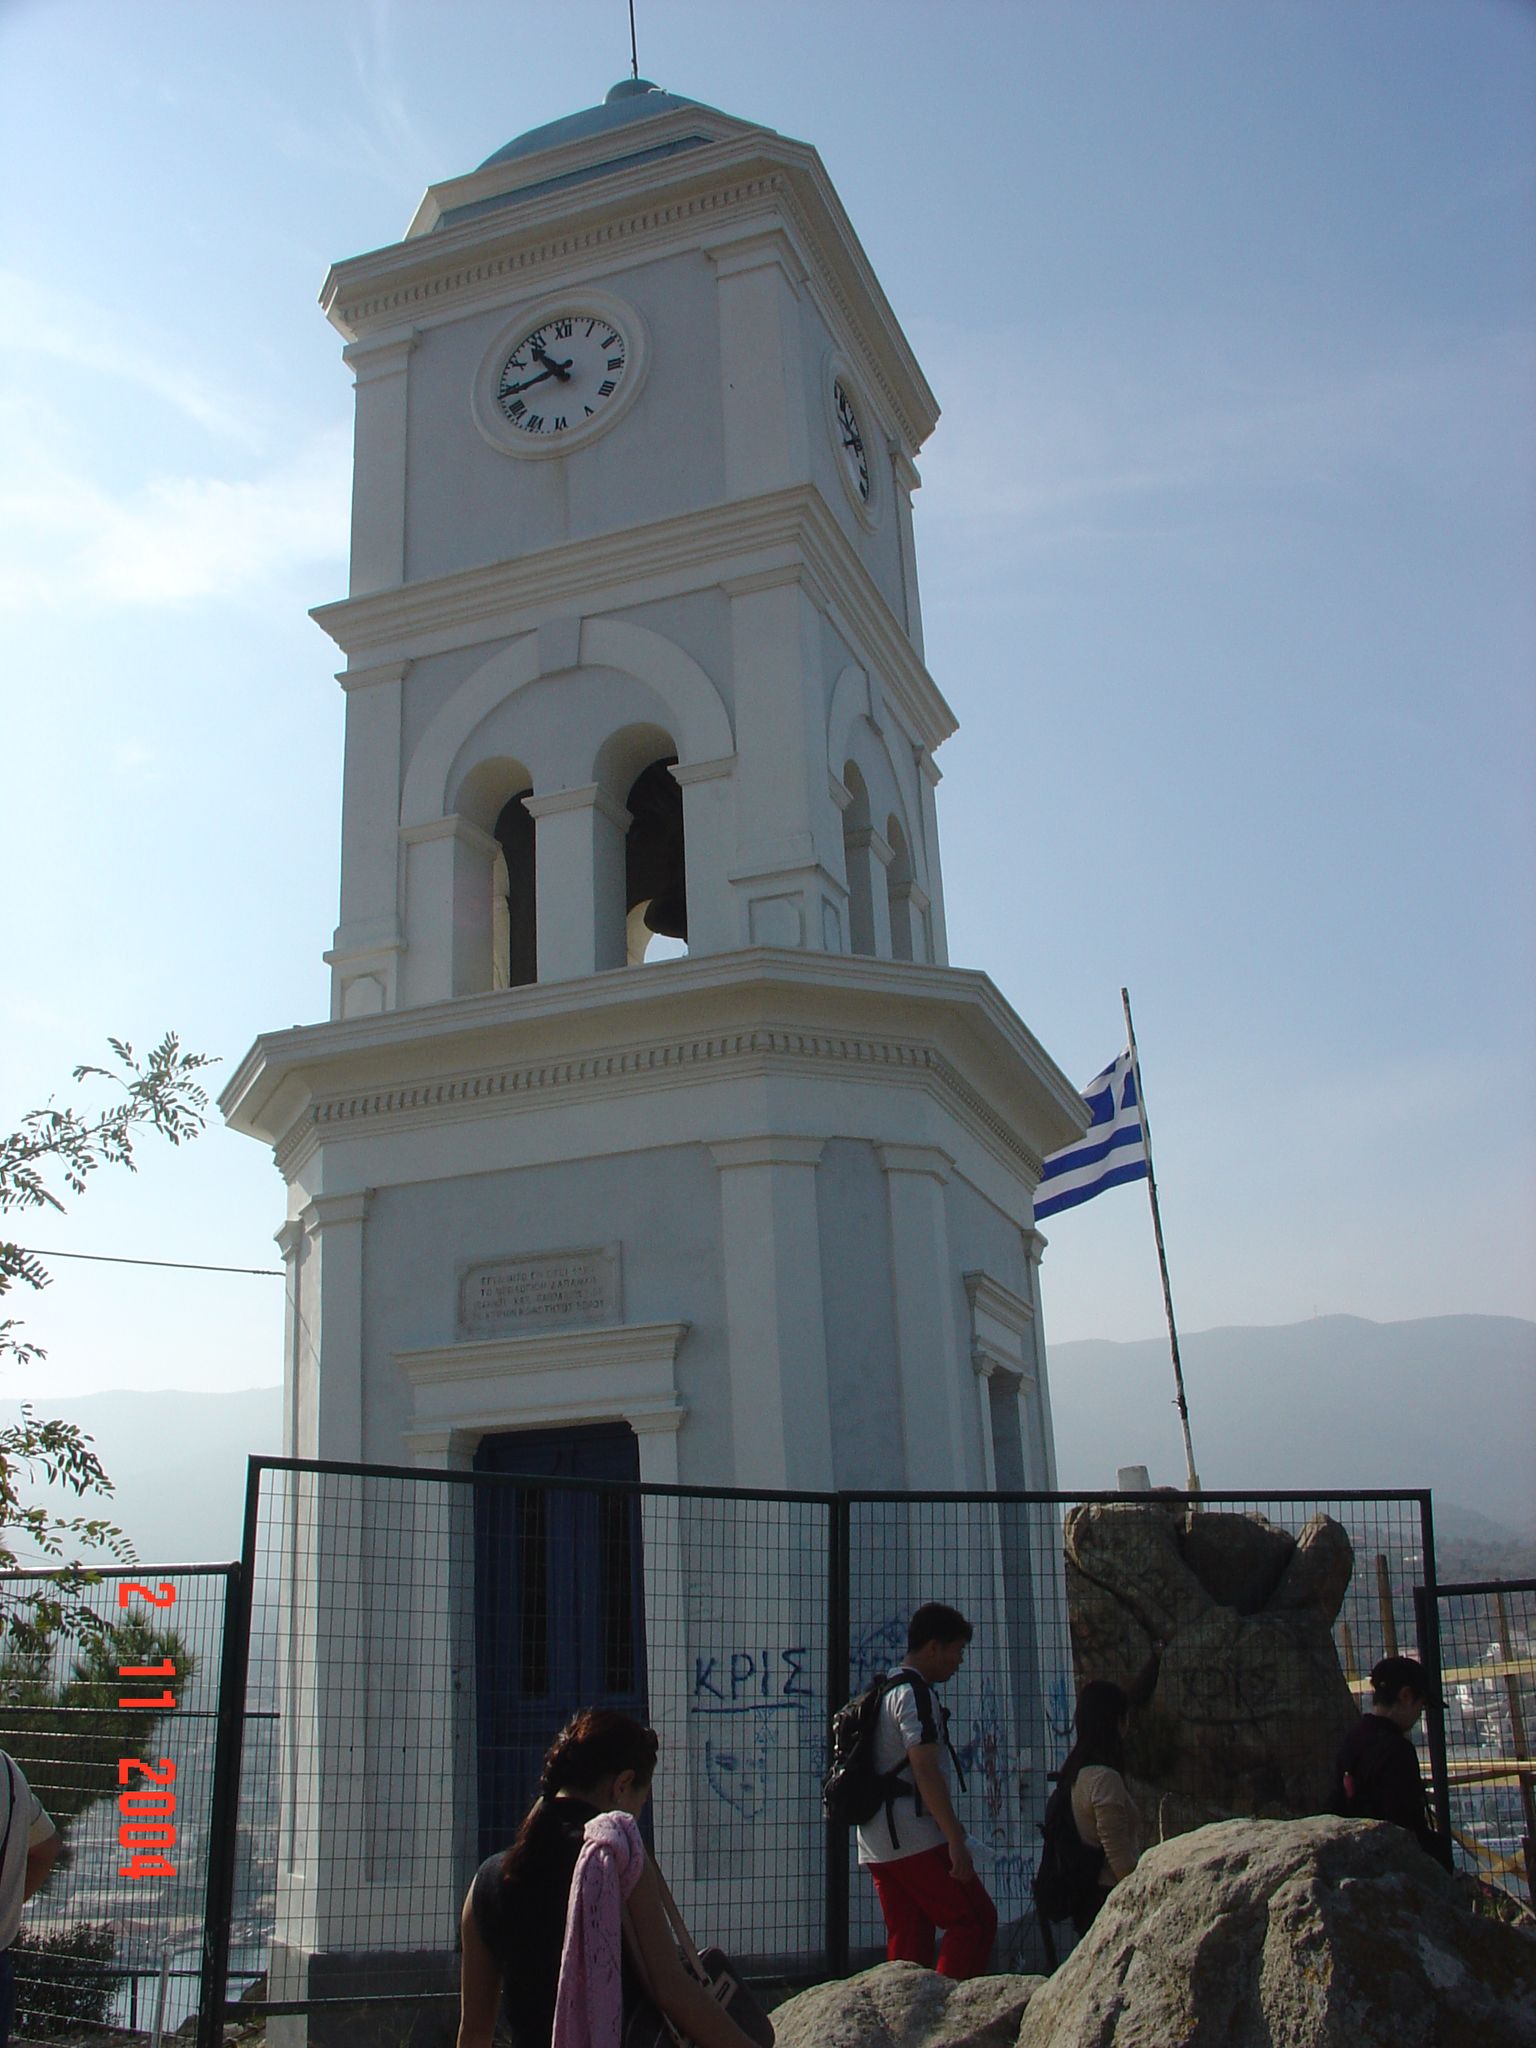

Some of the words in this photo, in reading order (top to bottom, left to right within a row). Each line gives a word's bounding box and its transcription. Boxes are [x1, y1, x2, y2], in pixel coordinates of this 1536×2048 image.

[555, 320, 572, 340] XII
[601, 334, 617, 349] II
[607, 357, 622, 371] III
[584, 405, 595, 417] V
[555, 416, 568, 430] VI
